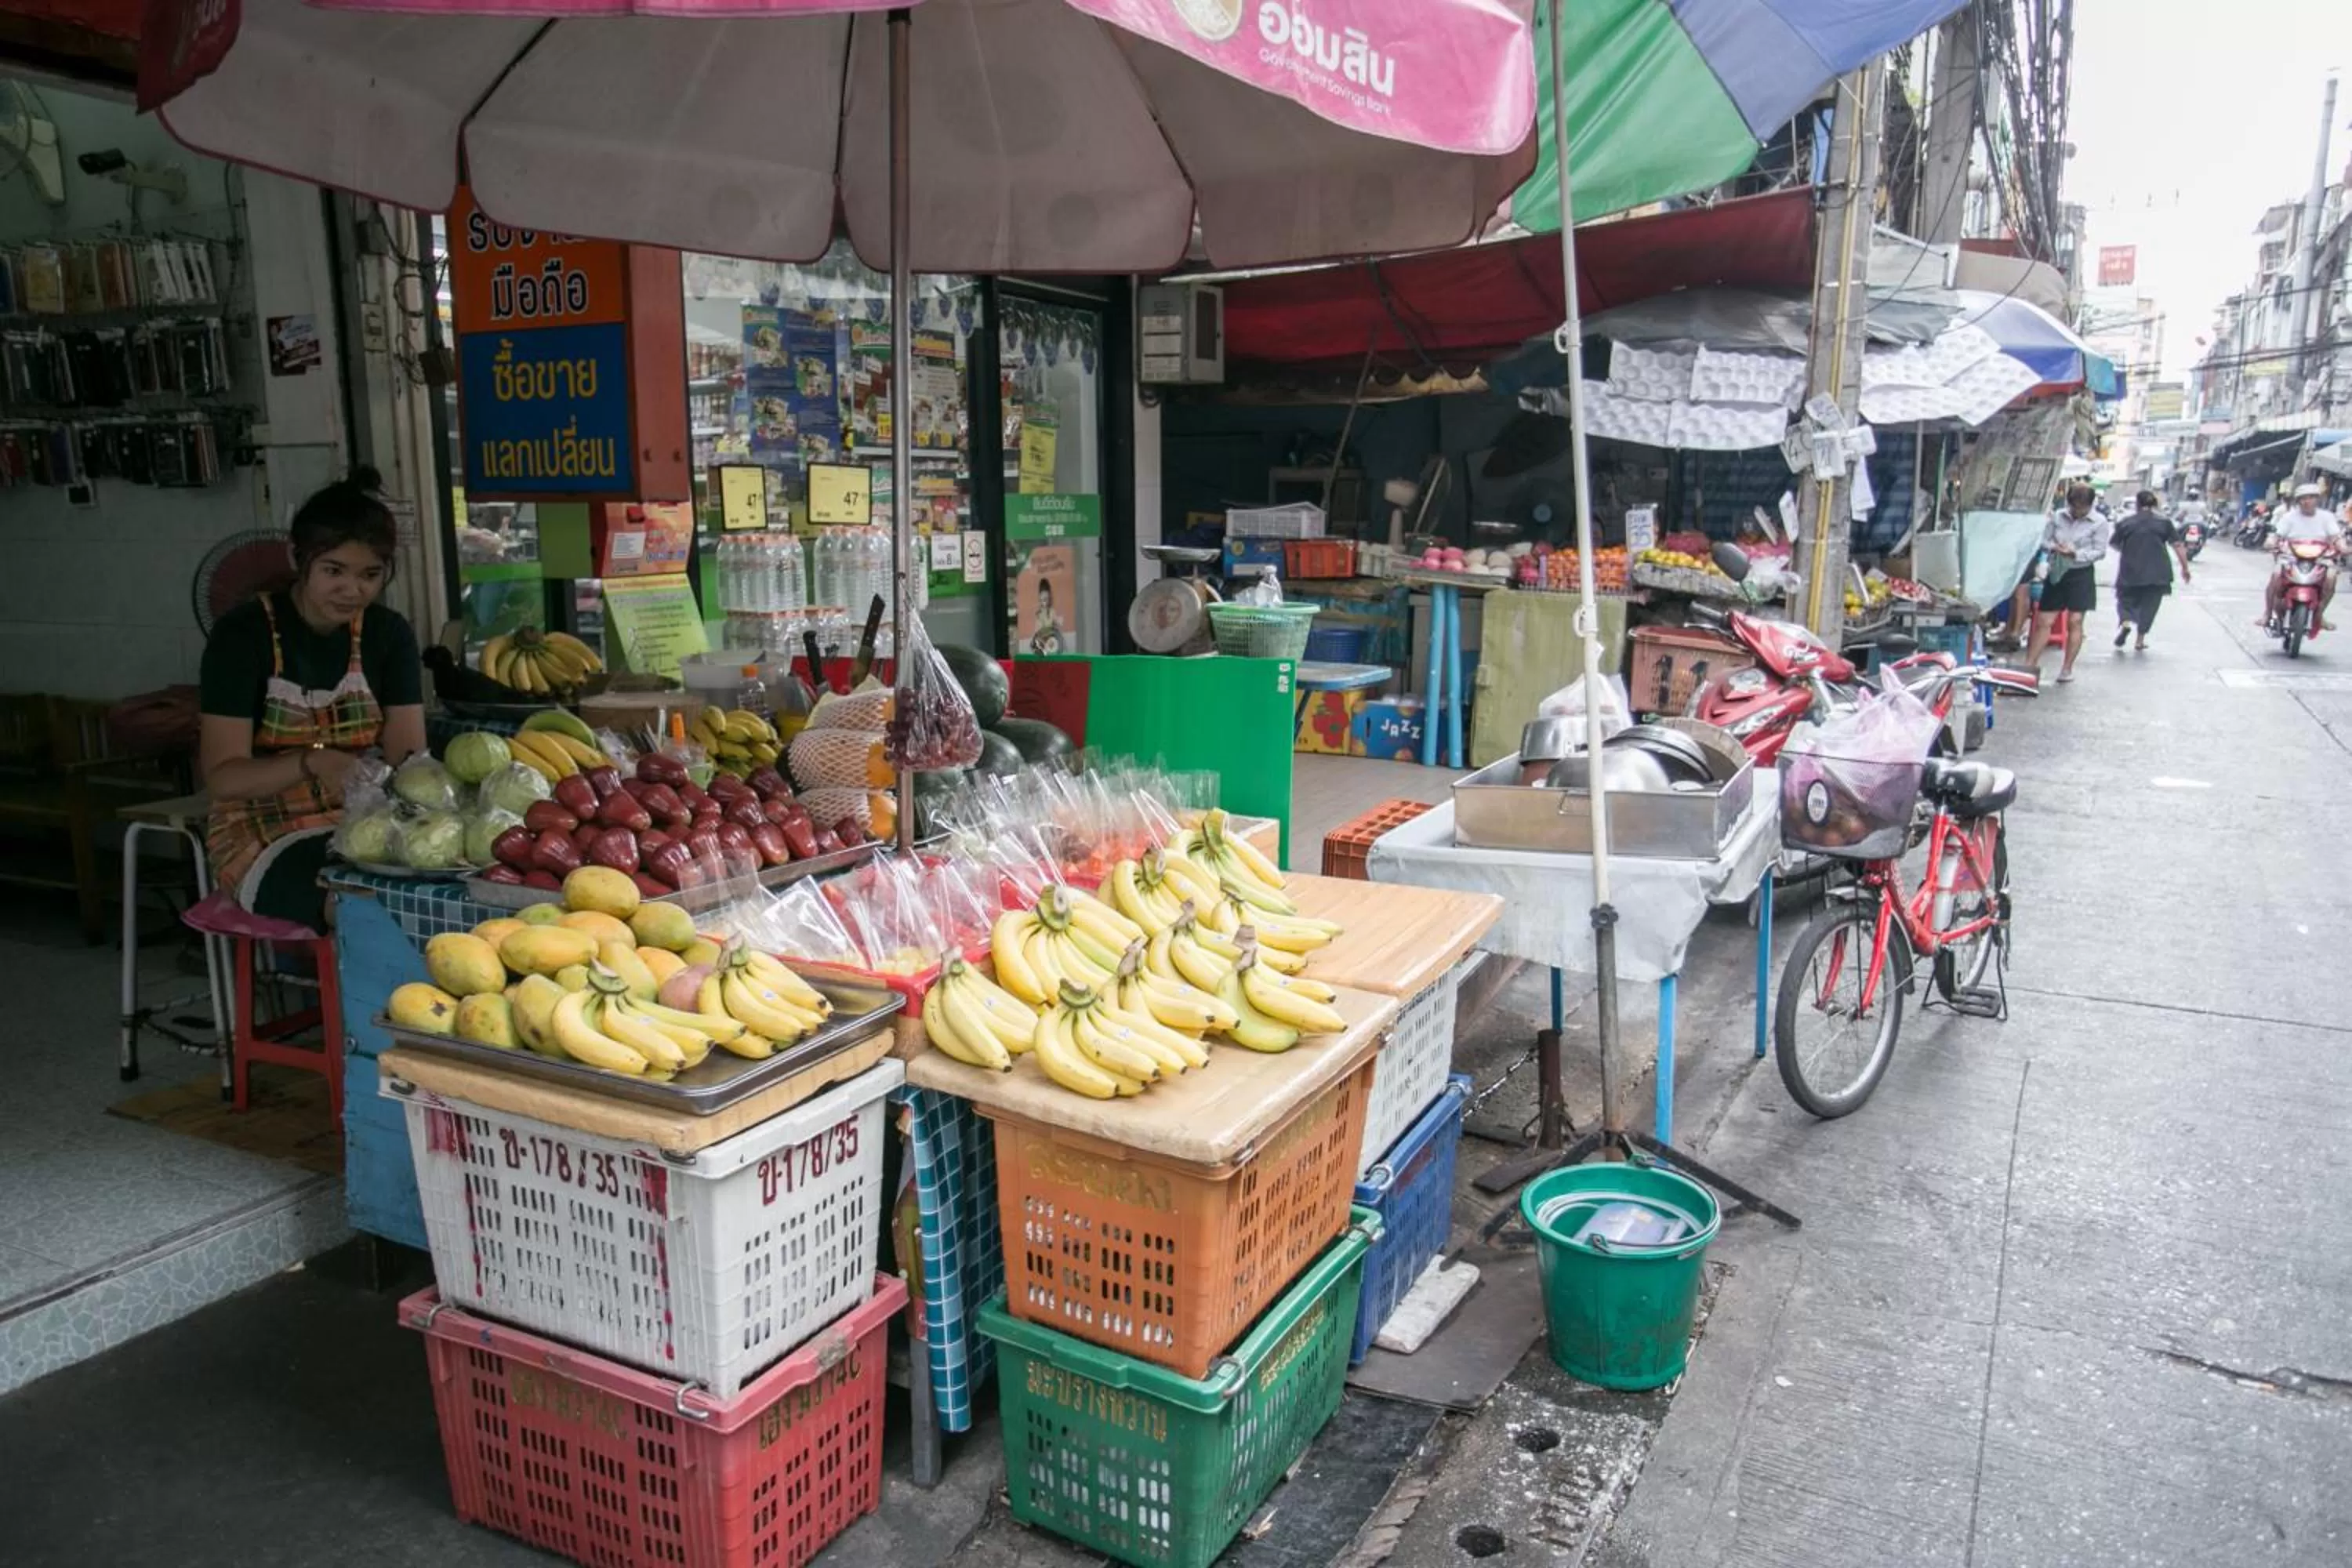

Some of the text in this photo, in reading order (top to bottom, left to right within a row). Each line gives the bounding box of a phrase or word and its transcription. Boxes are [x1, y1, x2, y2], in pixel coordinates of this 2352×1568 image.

[1258, 1, 1395, 97] ออมสิน
[492, 258, 587, 321] มือถือ
[493, 337, 597, 401] ซื้อขาย
[482, 415, 615, 477] แลกเปลี่ยน
[843, 491, 858, 506] 47
[1380, 717, 1421, 740] JAZZ
